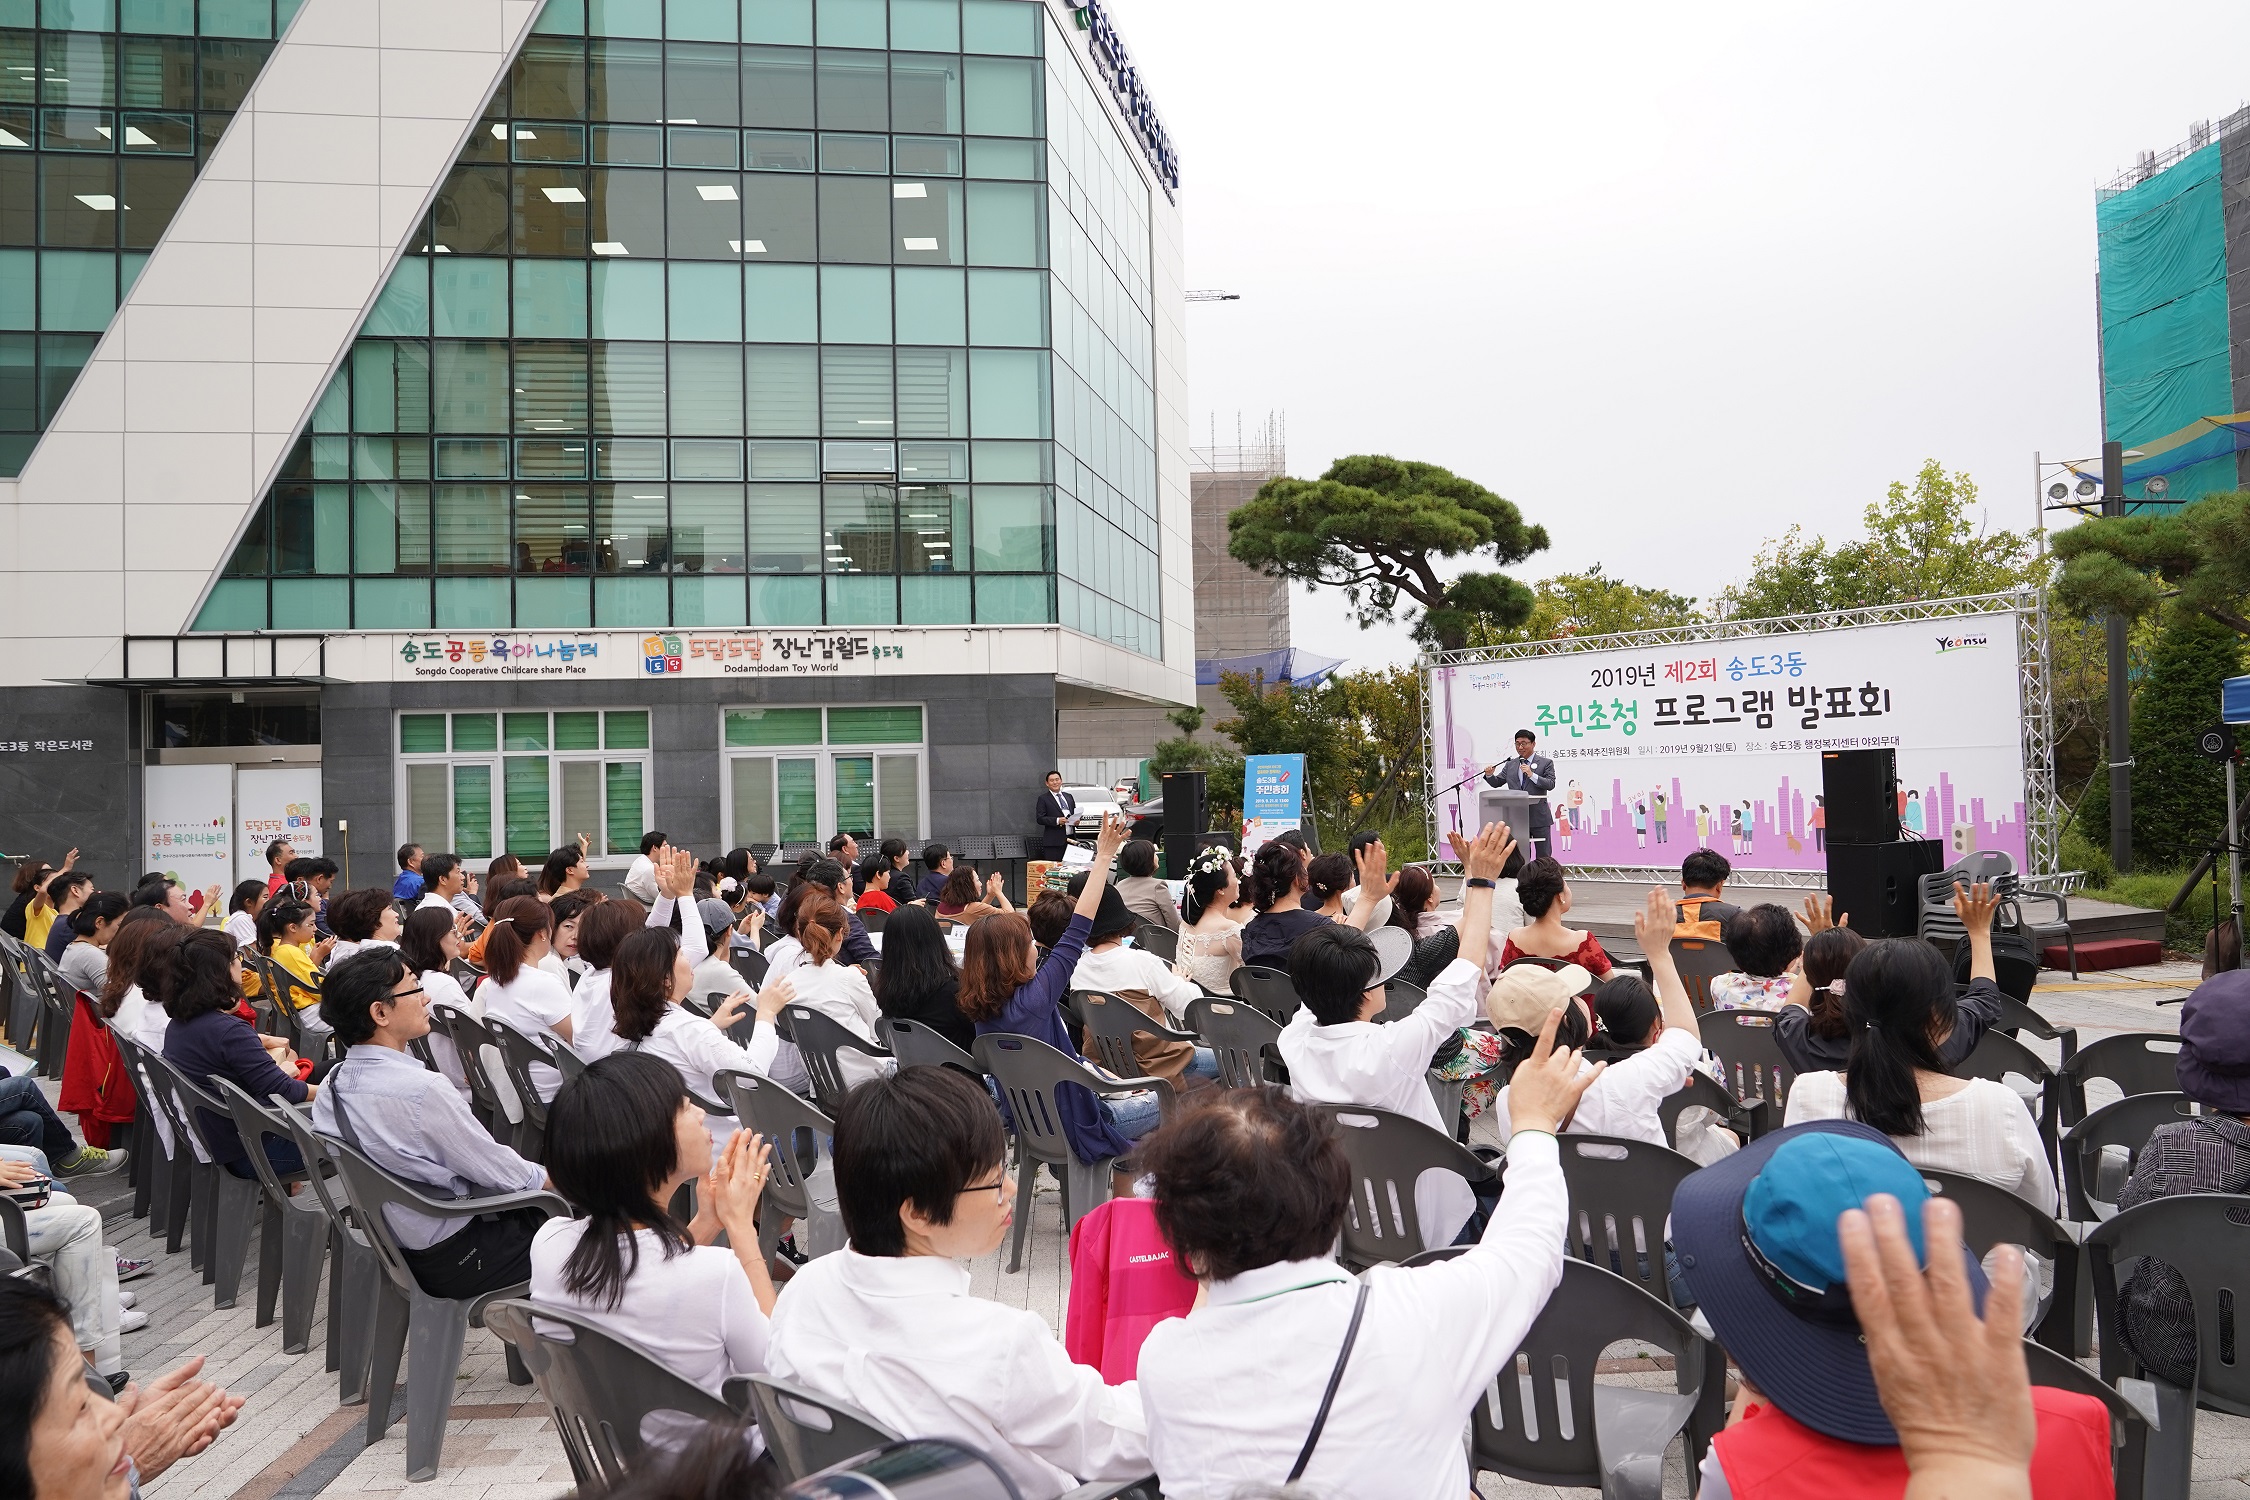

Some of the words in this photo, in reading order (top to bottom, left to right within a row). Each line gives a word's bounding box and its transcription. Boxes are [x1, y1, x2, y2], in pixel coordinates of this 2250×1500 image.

[400, 639, 598, 663] 송도공동육아나눔터
[689, 638, 764, 660] 도담도담
[772, 636, 869, 660] 장난감월드
[1936, 636, 1987, 651] Yeonsu
[415, 667, 447, 677] Songdo
[450, 666, 499, 677] Cooperative
[501, 665, 539, 675] Childcare
[541, 665, 563, 674] share
[565, 665, 587, 674] Place
[724, 663, 789, 673] Dodamdodam
[791, 663, 808, 674] Toy
[812, 662, 839, 672] World
[1591, 663, 1656, 689] 2019년
[1664, 657, 1718, 684] 제2회
[1725, 651, 1808, 682] 송도3동
[1534, 698, 1639, 739] 주민초청
[1653, 688, 1775, 730] 프로그램
[1788, 681, 1892, 731] 발표회
[34, 740, 94, 752] 작은도서관
[1552, 748, 1578, 759] 송도3동
[1579, 746, 1630, 757] 축제추진위원회
[1637, 745, 1653, 755] 일시
[1659, 744, 1688, 754] 2019년
[1689, 742, 1737, 754] 9월21일(토)
[1745, 741, 1763, 752] 장소
[1769, 739, 1802, 751] 송도3동
[1804, 737, 1859, 749] 행정복지센터
[1861, 735, 1900, 747] 야외무대
[245, 820, 283, 832] 도담도담
[151, 832, 227, 847] 공동육아나눔터
[1129, 1250, 1169, 1263] CASTELBAJAC
